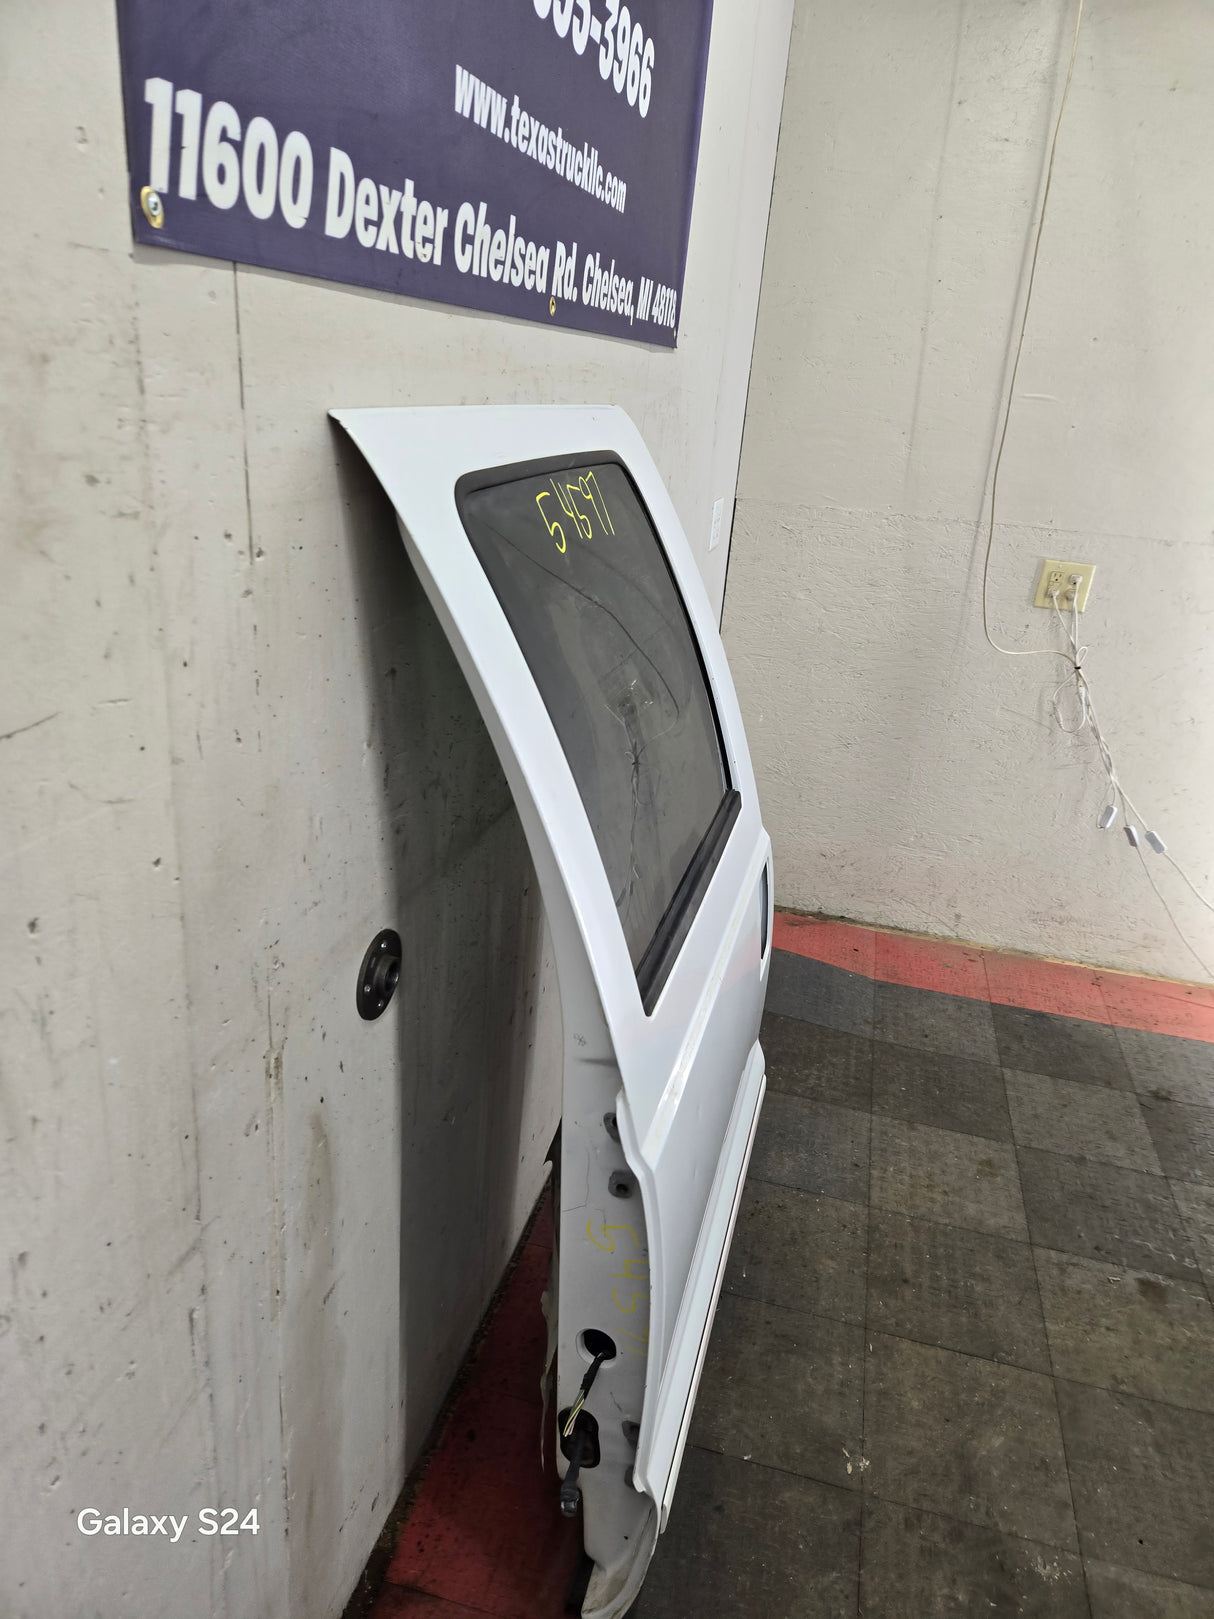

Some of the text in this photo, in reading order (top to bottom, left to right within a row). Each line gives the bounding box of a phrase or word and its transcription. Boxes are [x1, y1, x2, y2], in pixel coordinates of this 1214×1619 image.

[143, 76, 678, 329] 11600 Dexter Chelsea Rd. Chelsea, MI 48118
[454, 63, 628, 214] www.texastruckllc.com
[535, 470, 616, 554] 54597
